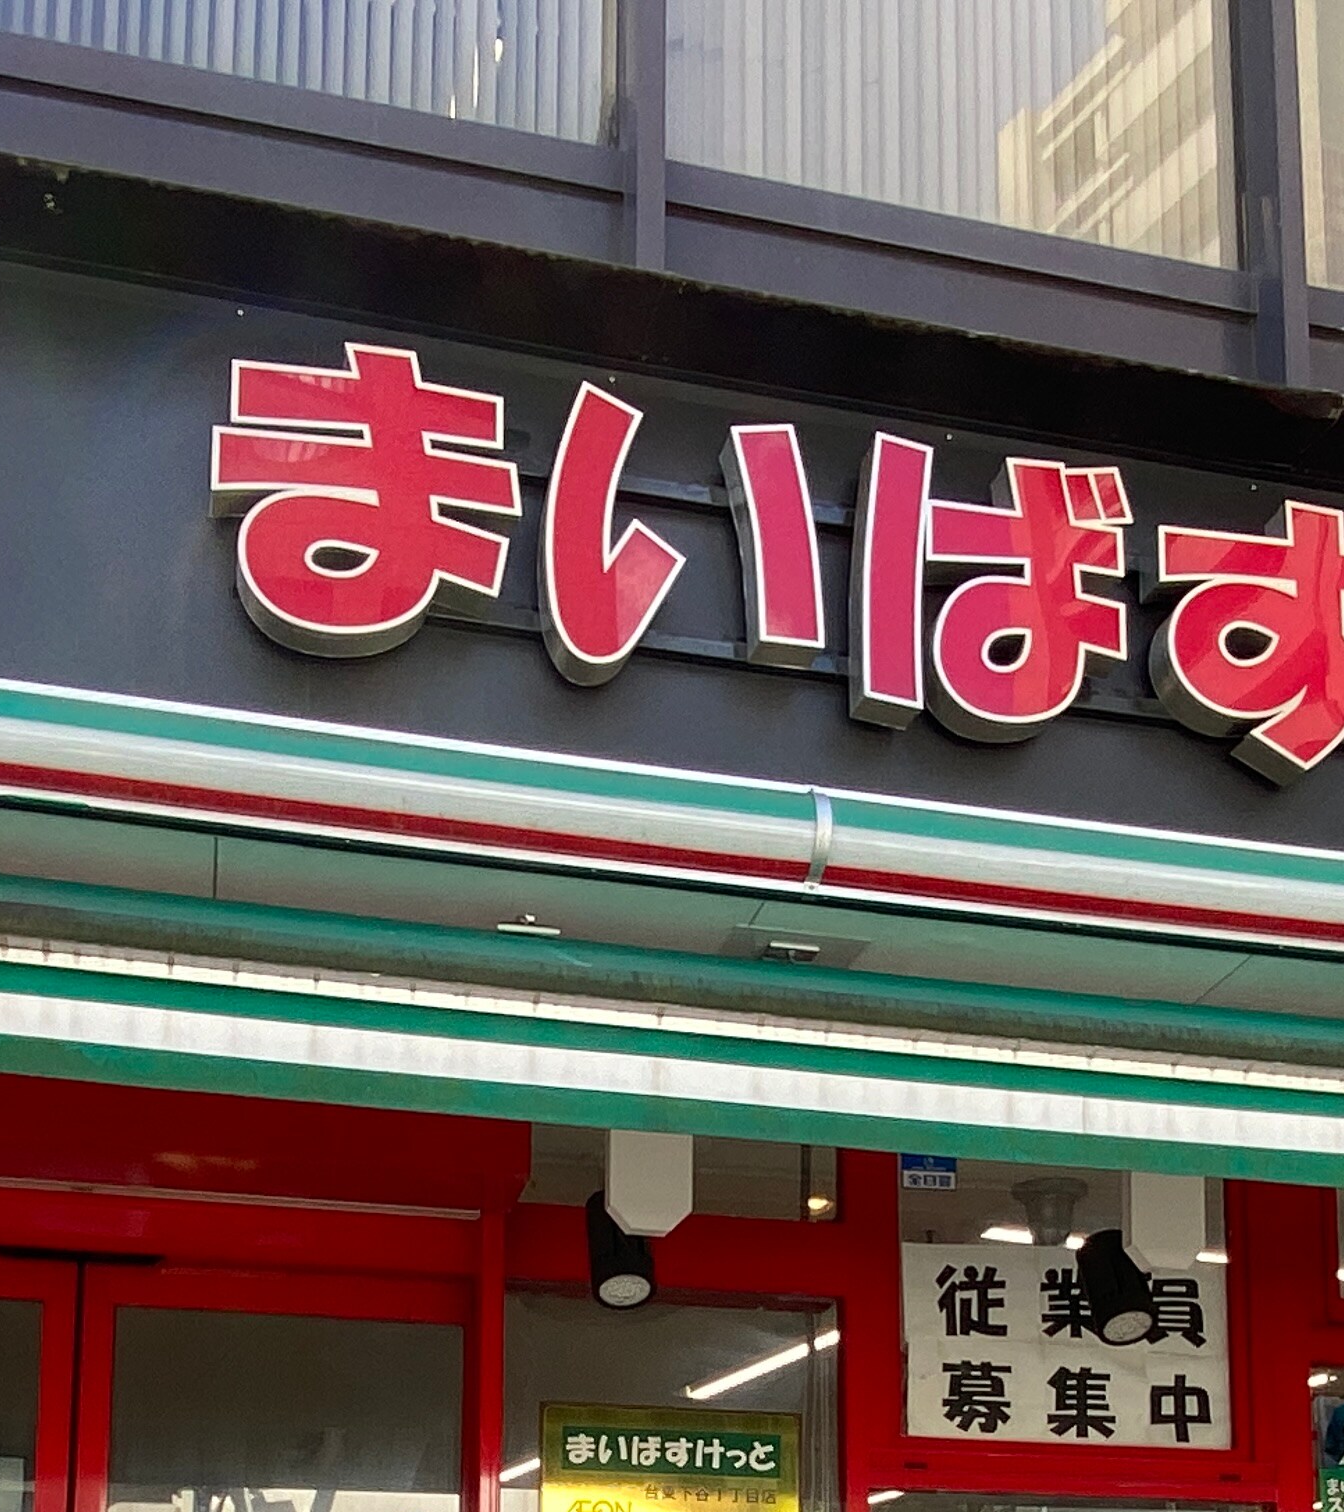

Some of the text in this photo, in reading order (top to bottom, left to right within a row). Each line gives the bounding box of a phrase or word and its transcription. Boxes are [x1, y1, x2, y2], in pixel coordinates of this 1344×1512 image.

[942, 1361, 1212, 1443] 募集中
[565, 1432, 777, 1472] まいばすけっと
